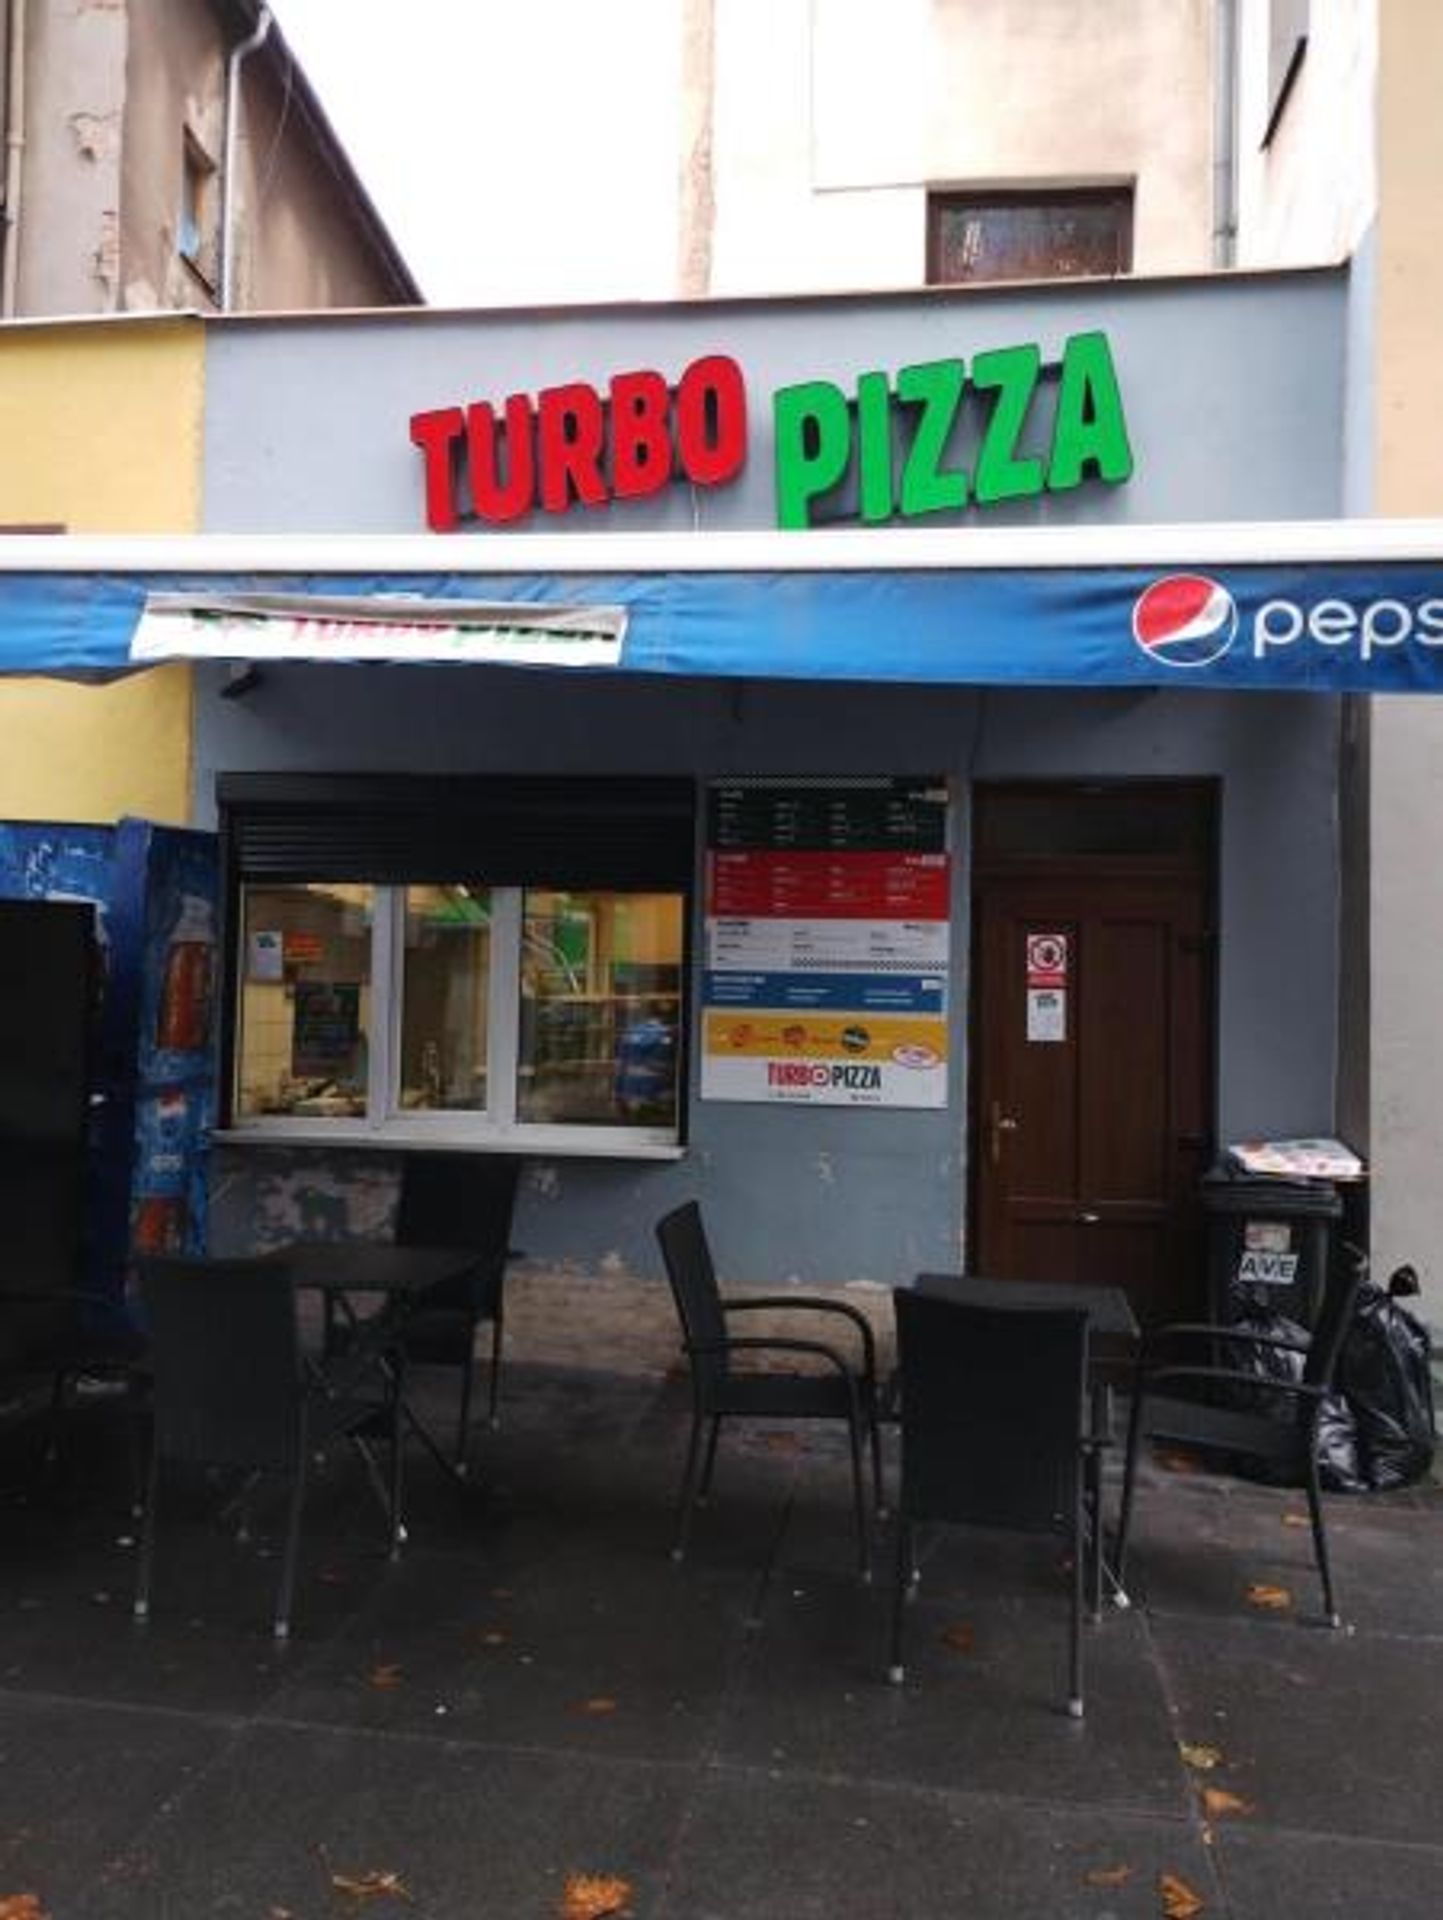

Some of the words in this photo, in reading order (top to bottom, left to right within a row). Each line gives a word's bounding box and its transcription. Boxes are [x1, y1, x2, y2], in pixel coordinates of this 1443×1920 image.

[410, 354, 749, 533] TURBO
[773, 330, 1135, 532] PIZZA
[831, 1065, 881, 1089] PIZZA
[1241, 1257, 1295, 1279] AVE
